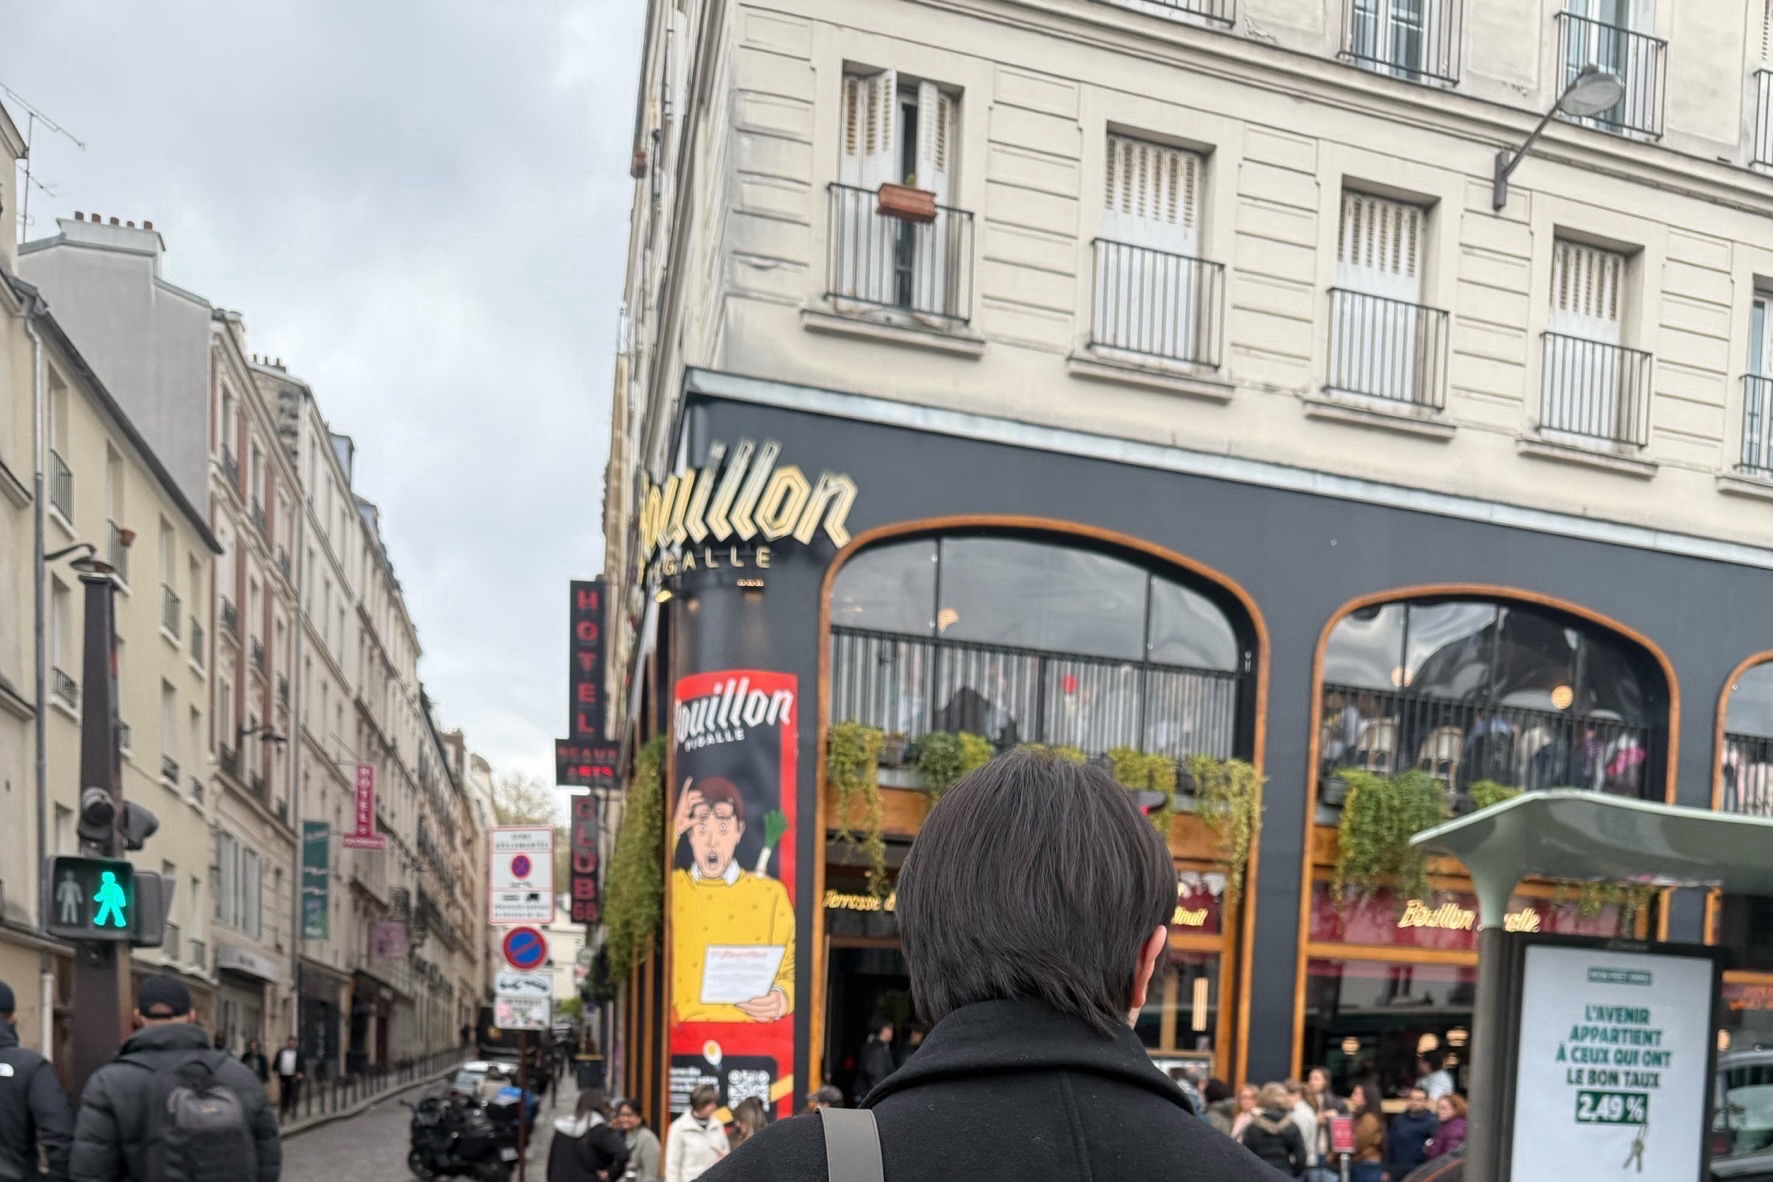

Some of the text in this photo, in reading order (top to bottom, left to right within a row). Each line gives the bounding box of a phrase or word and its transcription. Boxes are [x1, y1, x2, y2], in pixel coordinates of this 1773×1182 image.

[576, 589, 599, 733] HOTEL
[574, 797, 597, 899] CLUB
[1397, 899, 1476, 931] Bouillon
[1585, 1005, 1650, 1025] L'AVENIR
[1569, 1025, 1663, 1046] APPARTIENT
[1571, 1046, 1609, 1064] CEUX
[1613, 1048, 1639, 1066] QUI
[1642, 1050, 1672, 1068] ONT
[1567, 1069, 1660, 1088] LE BON TAUX
